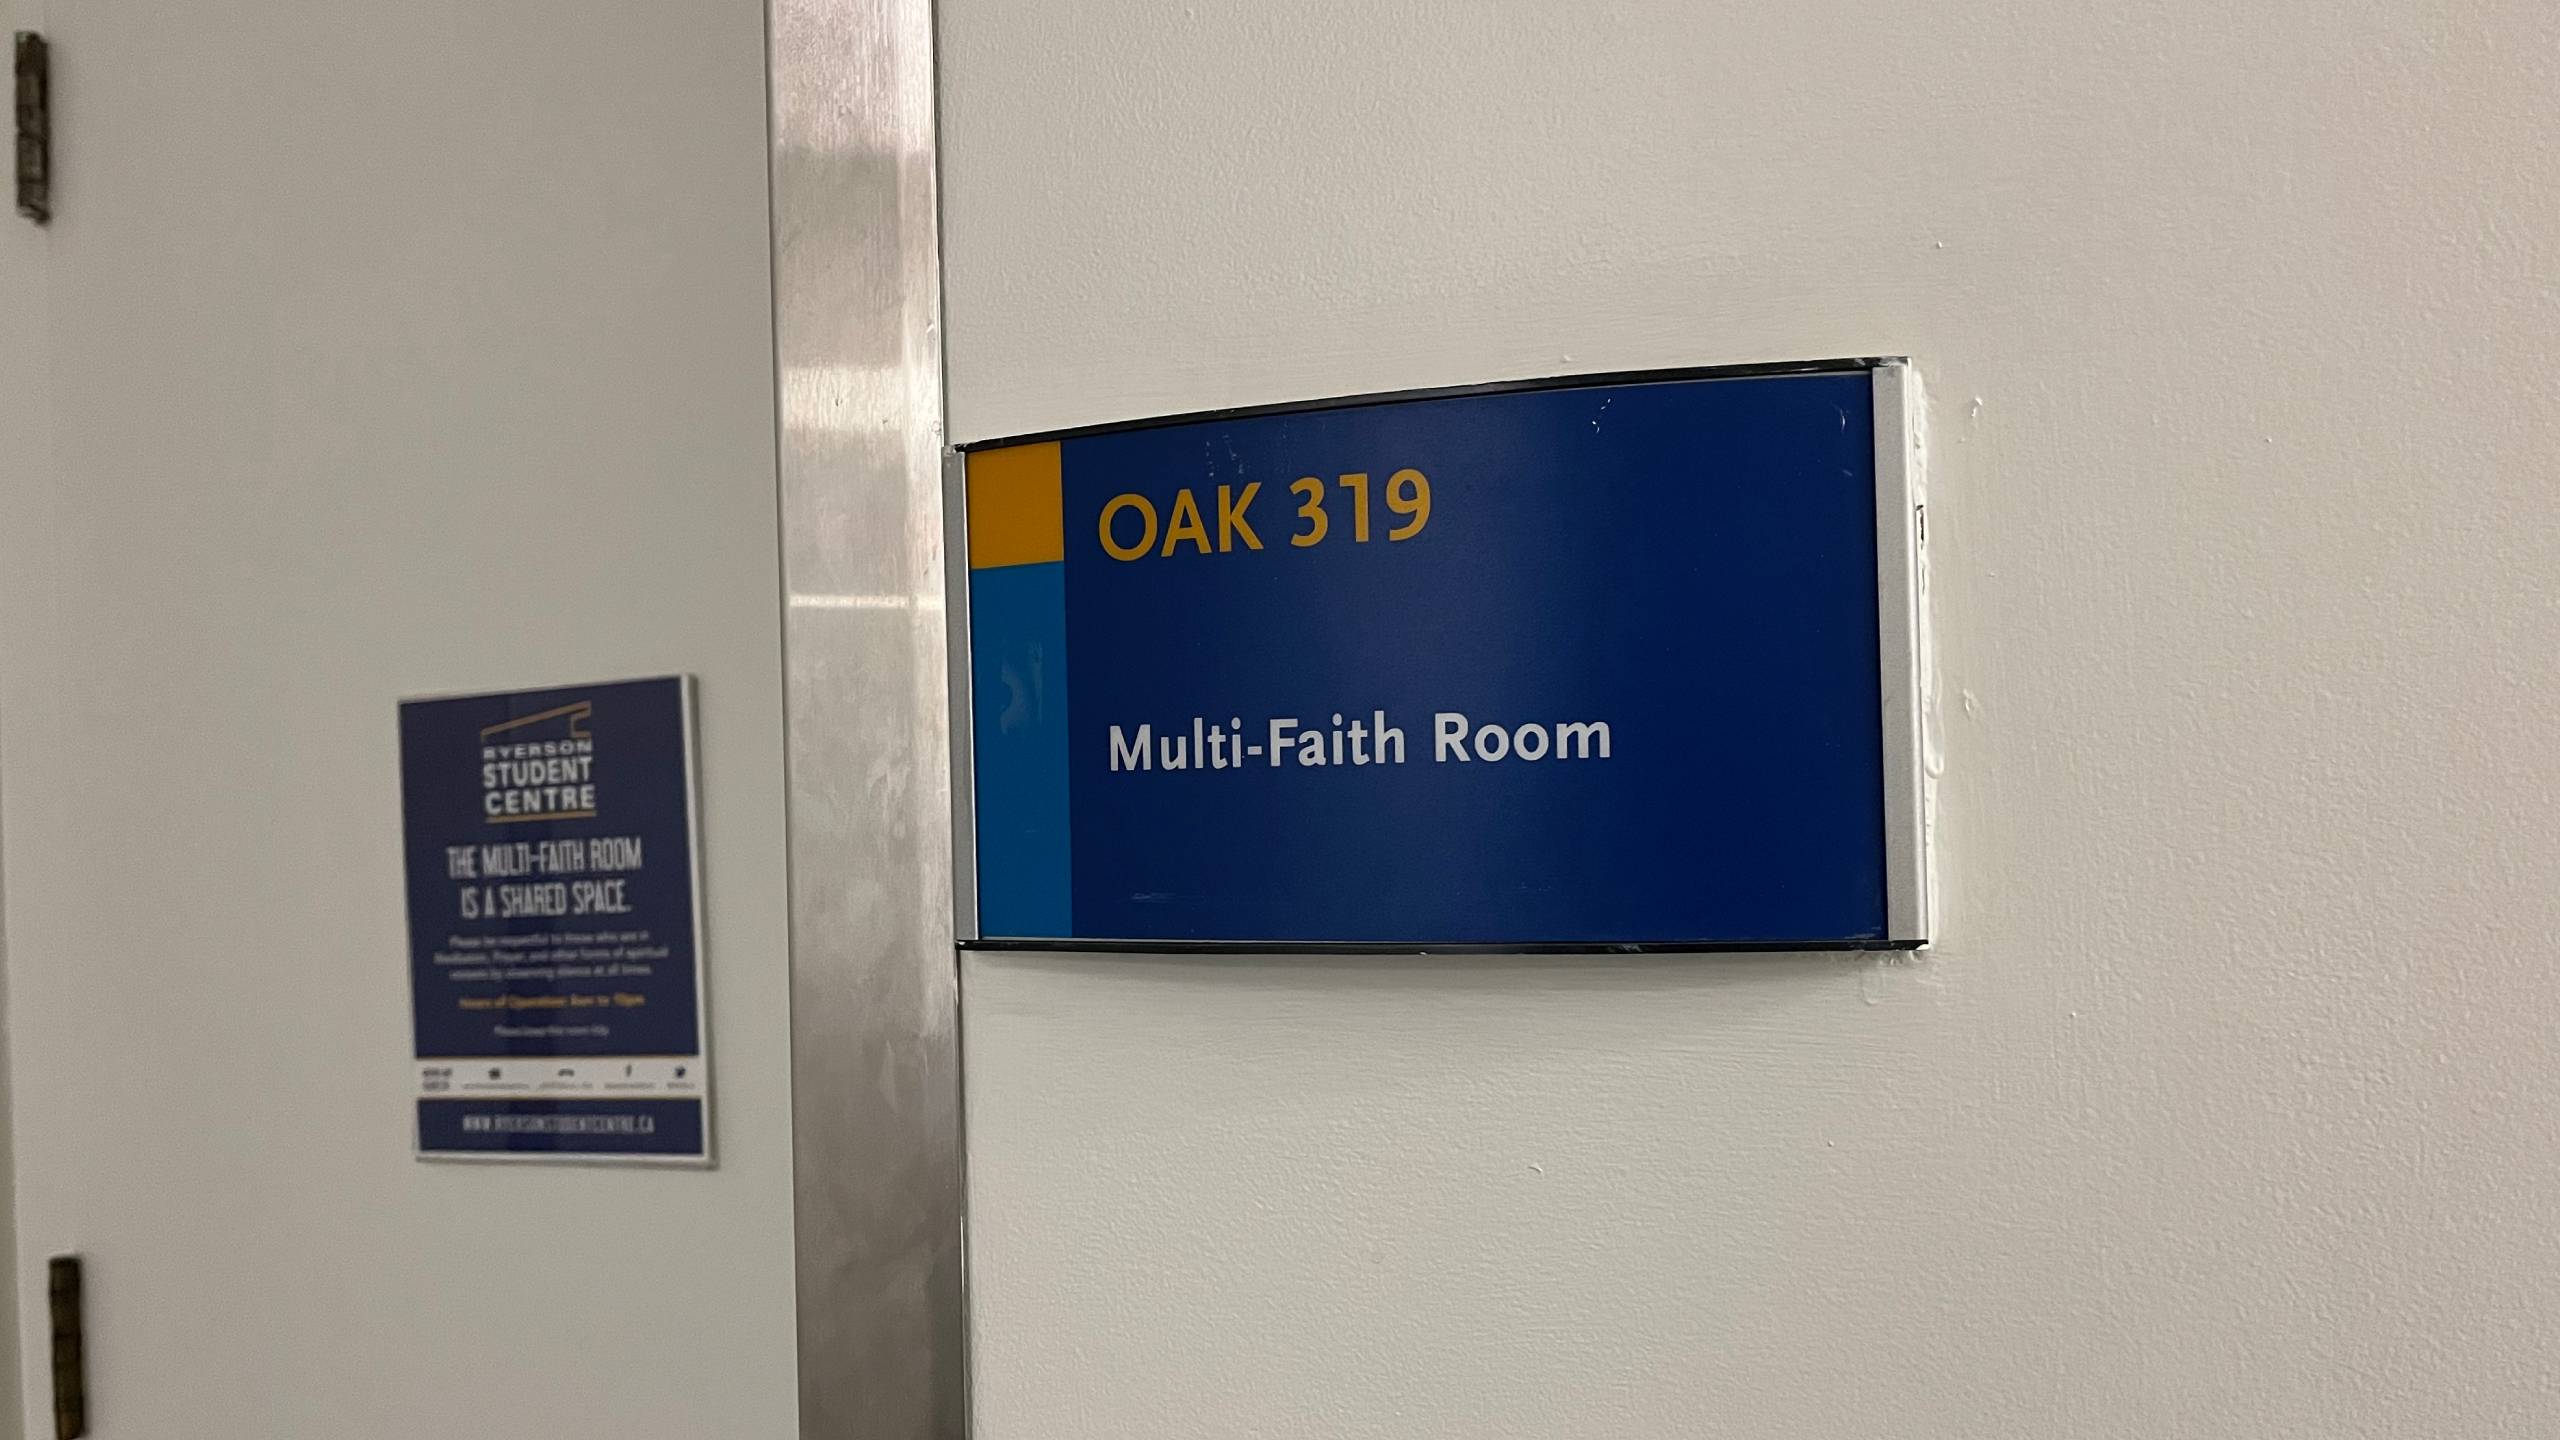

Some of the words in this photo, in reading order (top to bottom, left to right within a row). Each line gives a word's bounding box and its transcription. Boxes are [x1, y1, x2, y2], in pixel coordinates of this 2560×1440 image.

[1098, 481, 1264, 563] OAK
[1290, 468, 1433, 548] 319
[483, 739, 593, 759] RYERSON
[1108, 709, 1406, 774] Multi-Faith
[1433, 710, 1612, 765] Room
[483, 757, 592, 788] STUDENT
[485, 784, 596, 815] CENTRE
[446, 845, 478, 879] THE
[482, 839, 585, 877] MULTI-FAITH
[590, 836, 643, 872] ROOM
[461, 887, 479, 919] IS
[484, 886, 496, 917] A
[500, 883, 567, 918] SHARED
[572, 879, 632, 915] SPACE.
